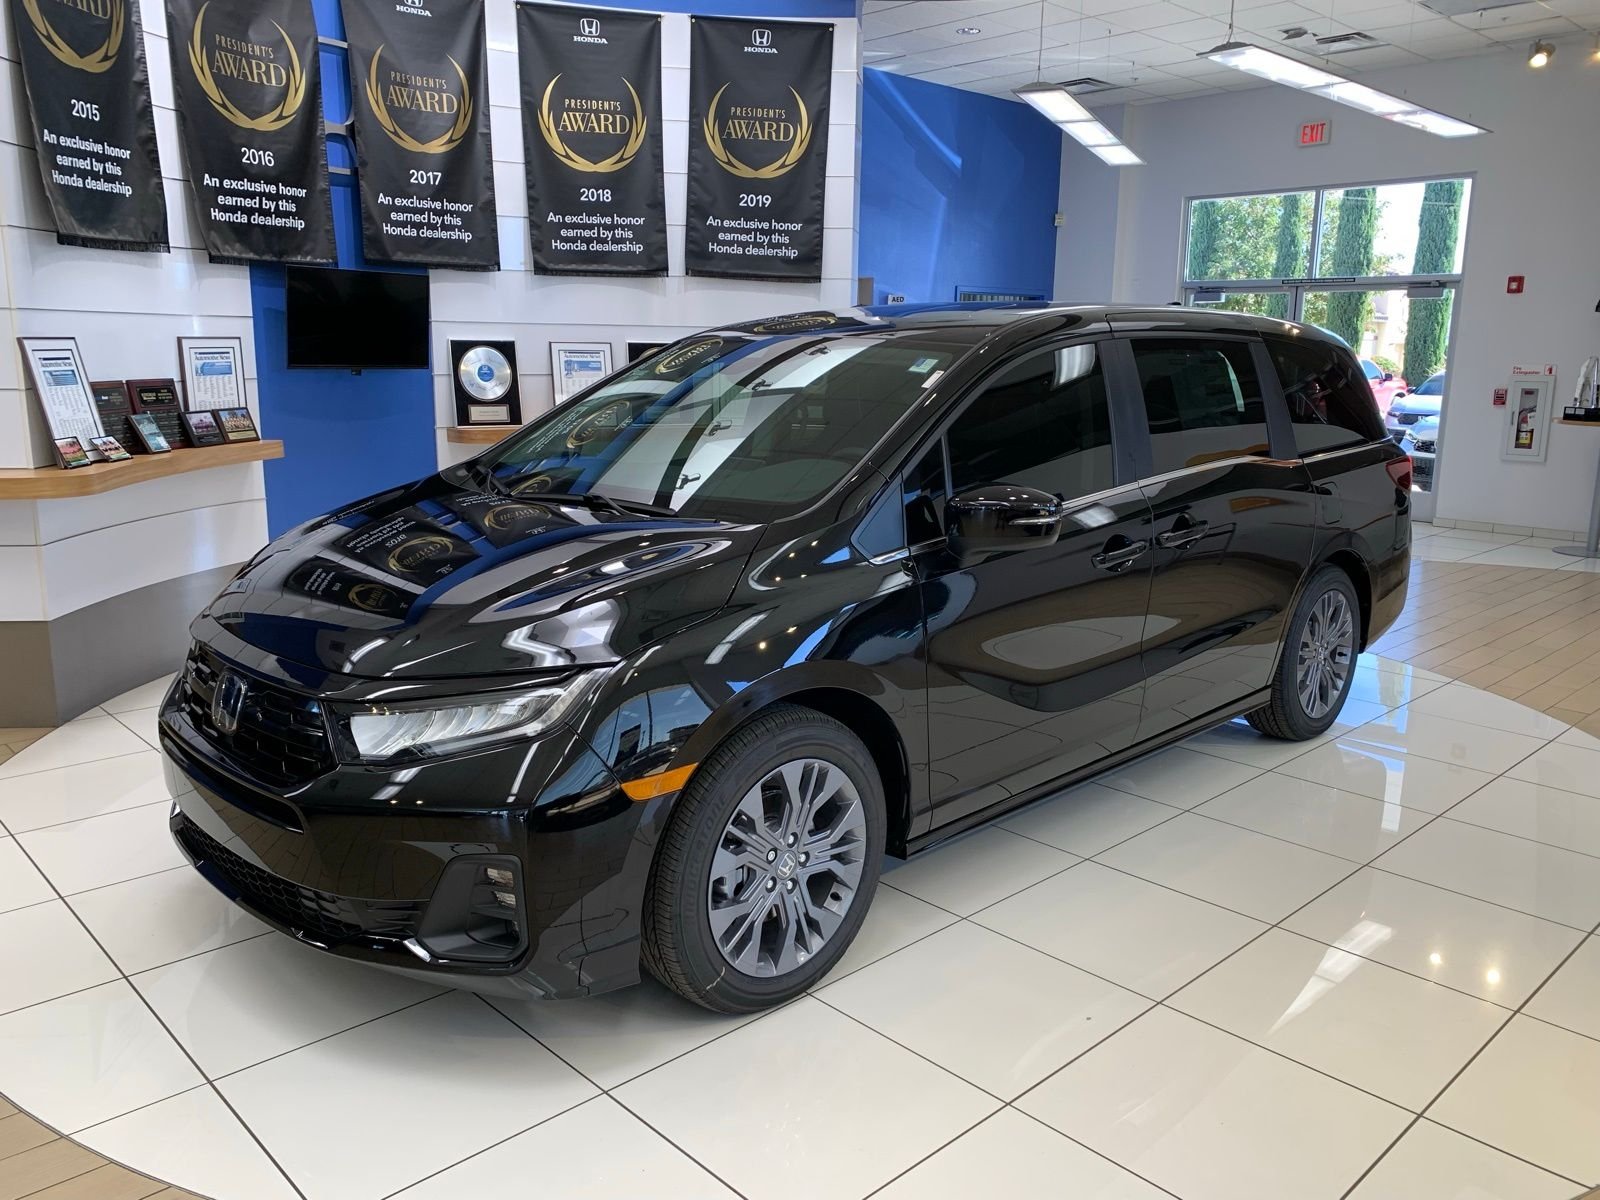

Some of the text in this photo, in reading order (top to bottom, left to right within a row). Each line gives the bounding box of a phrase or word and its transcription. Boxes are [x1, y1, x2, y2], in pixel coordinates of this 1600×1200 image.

[396, 5, 432, 16] HONDA
[216, 35, 273, 58] PRESIDENT'S
[574, 36, 608, 44] HONDA
[212, 50, 286, 86] AWARD
[392, 72, 446, 89] PRESIDENT'S
[386, 86, 457, 113] AWARD
[565, 99, 620, 110] PRESIDENT'S
[71, 99, 100, 121] 2015
[731, 107, 785, 118] PRESIDENT'S
[558, 112, 629, 134] AWARD
[722, 120, 794, 142] AWARD
[1302, 123, 1326, 144] EXIT
[44, 129, 131, 160] An exclusive honor
[56, 155, 122, 176] earned by this
[241, 148, 274, 166] 2016
[52, 170, 132, 197] Honda dealership
[204, 174, 306, 197] An exclusive honor
[410, 170, 442, 185] 2017
[378, 193, 473, 212] An exclusive honor
[580, 188, 611, 202] 2018
[739, 194, 771, 207] 2019
[218, 196, 296, 212] earned by this
[211, 208, 304, 230] Honda dealership
[391, 212, 462, 226] earned by this
[547, 212, 645, 225] An exclusive honor
[706, 216, 802, 230] An exclusive honor
[383, 223, 472, 243] Honda dealership
[561, 227, 633, 240] earned by this
[718, 232, 789, 245] earned by this
[552, 240, 643, 254] Honda dealership
[709, 242, 798, 259] Honda dealership
